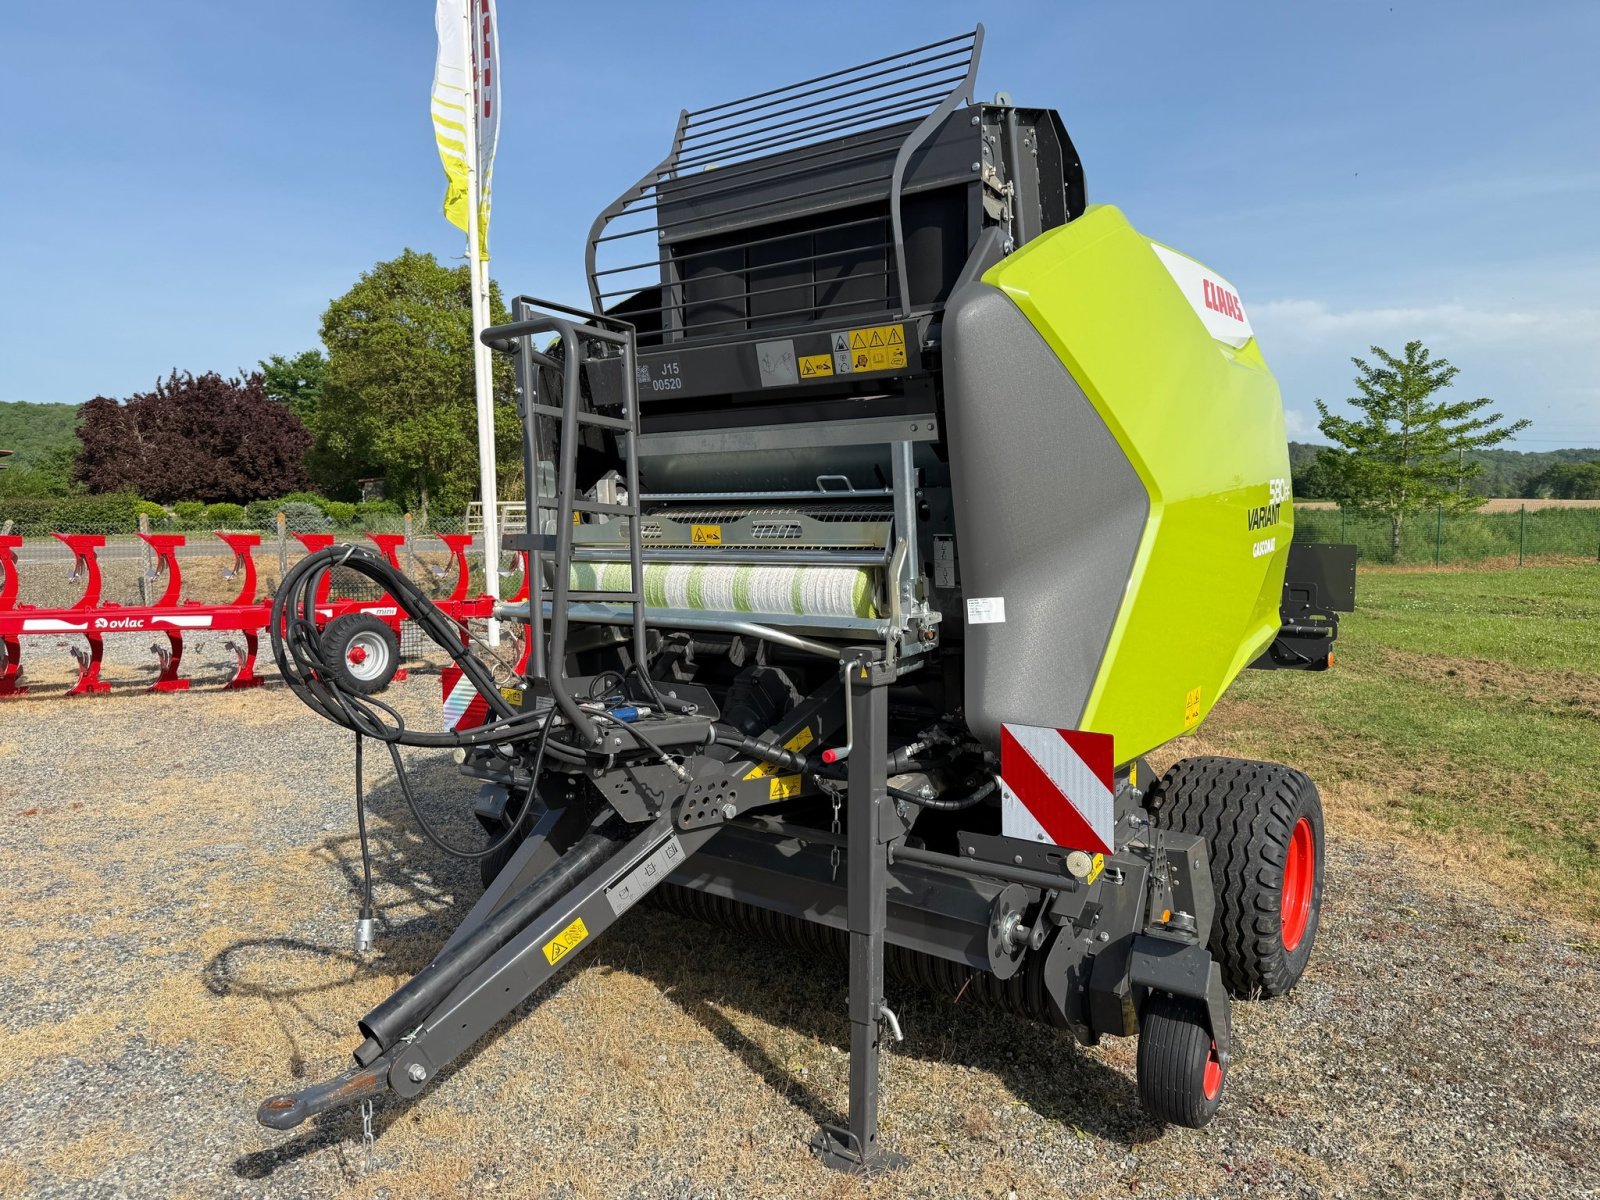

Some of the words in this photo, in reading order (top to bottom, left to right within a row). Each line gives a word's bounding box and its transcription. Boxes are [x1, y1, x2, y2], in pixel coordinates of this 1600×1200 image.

[1203, 279, 1244, 323] CLAAS
[661, 362, 679, 375] J15
[653, 377, 682, 391] 00520
[1248, 503, 1281, 532] VARIANT
[109, 616, 145, 629] ovlac
